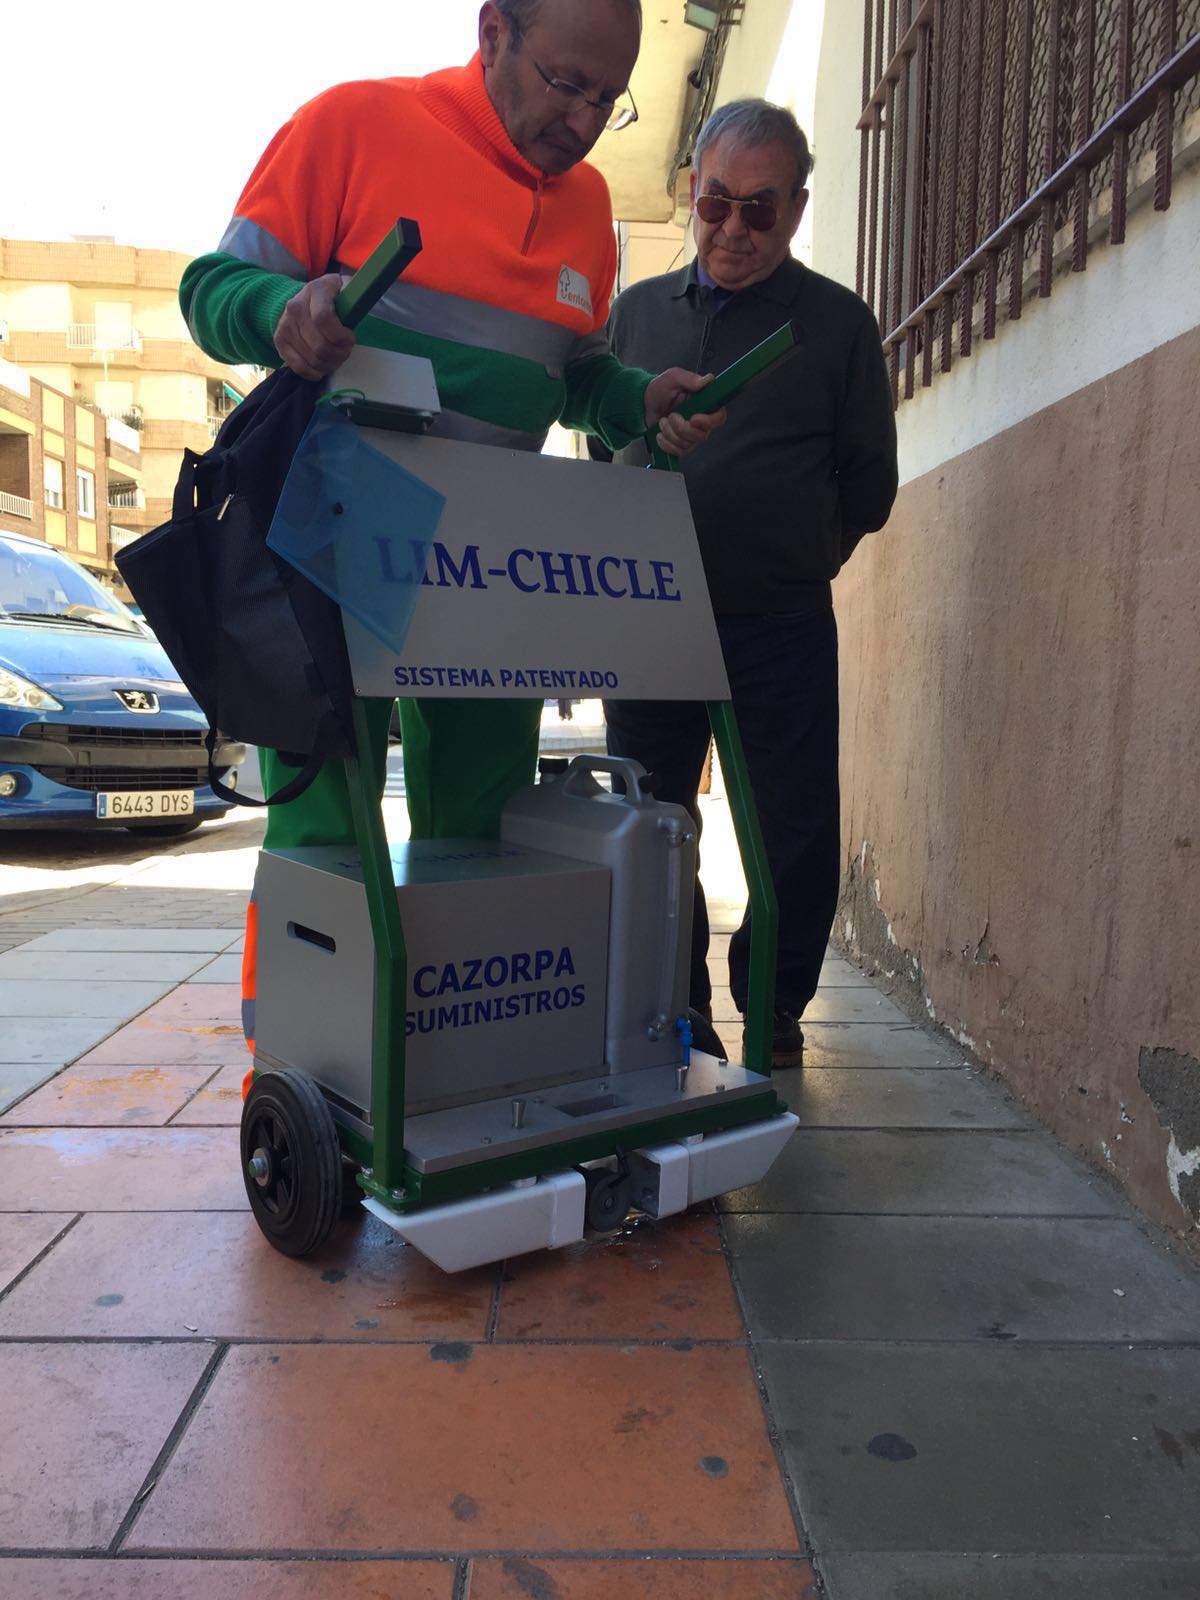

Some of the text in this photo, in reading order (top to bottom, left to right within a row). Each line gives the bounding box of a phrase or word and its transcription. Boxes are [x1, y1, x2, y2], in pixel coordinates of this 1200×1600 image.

[373, 536, 682, 602] LIM-CHICLE
[394, 666, 619, 689] SISTEMA PATENTADO
[112, 795, 154, 815] 6443
[160, 794, 190, 813] DYS
[413, 946, 576, 998] CAZORPA
[405, 984, 586, 1037] SUMINISTROS
